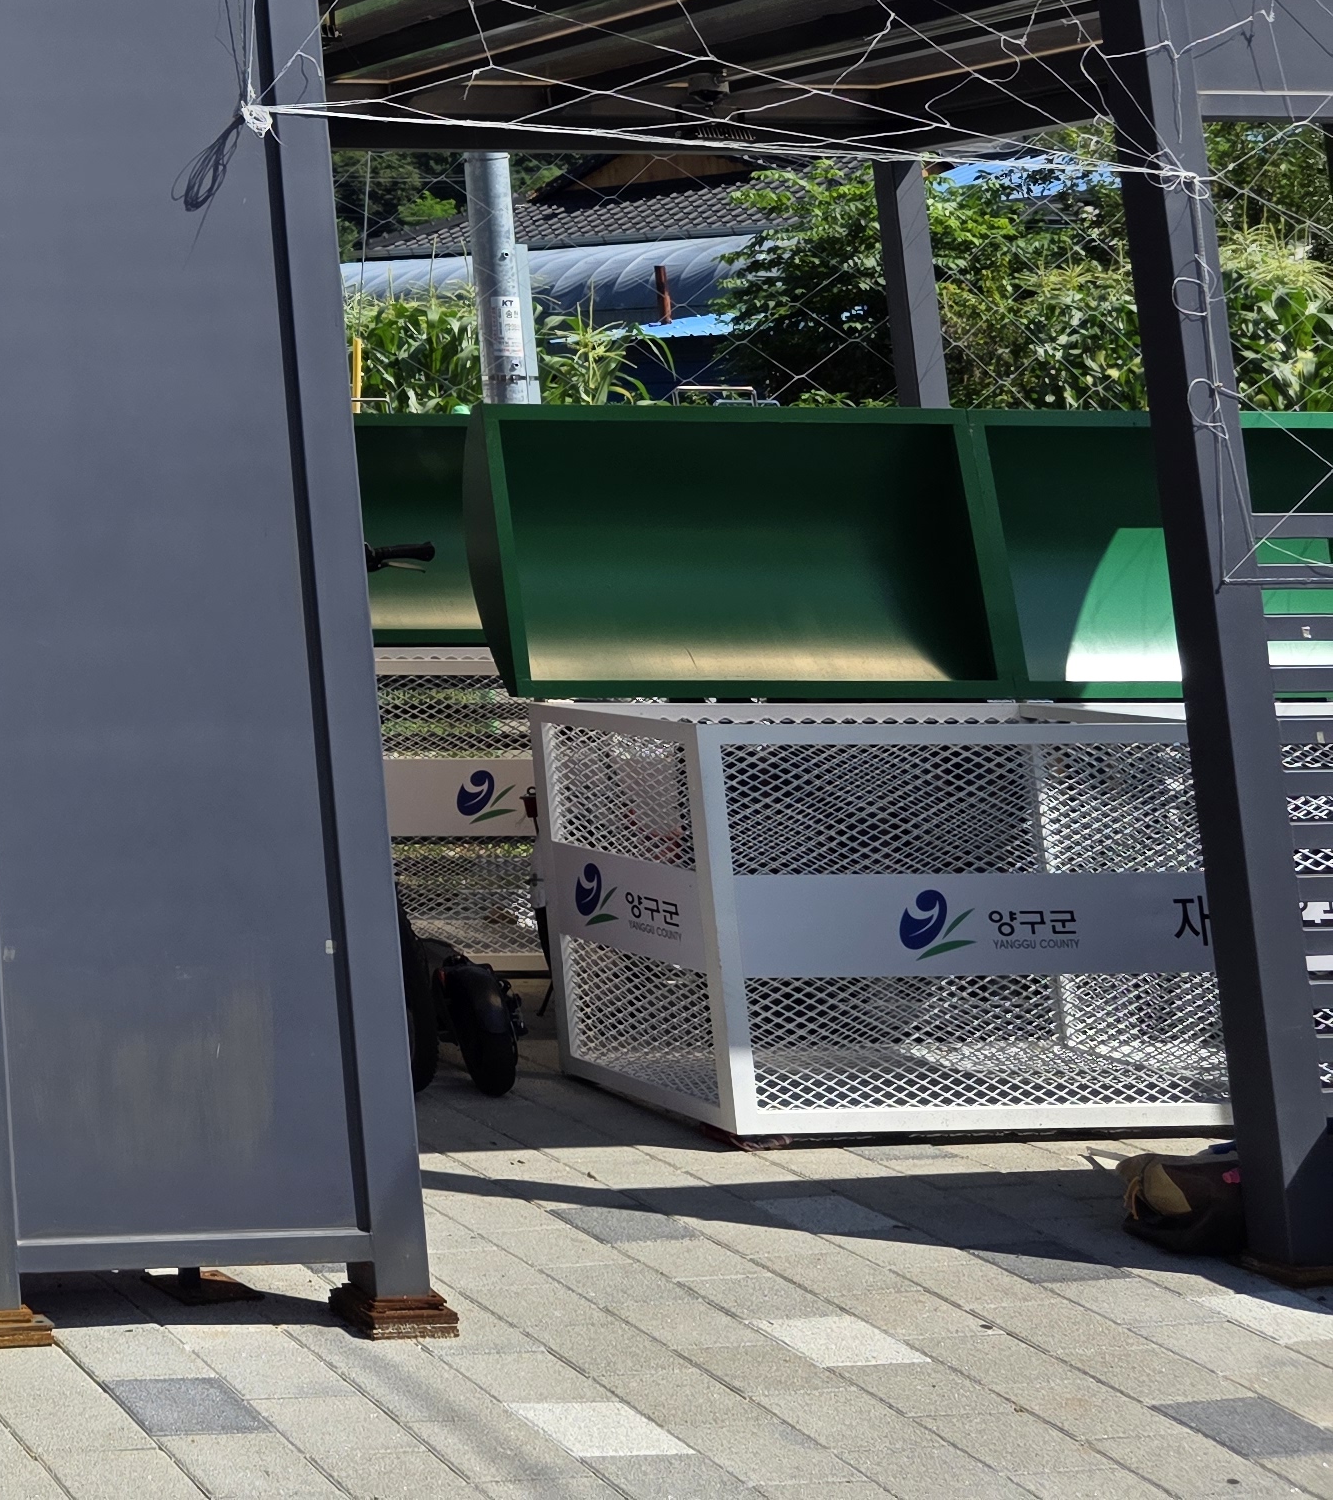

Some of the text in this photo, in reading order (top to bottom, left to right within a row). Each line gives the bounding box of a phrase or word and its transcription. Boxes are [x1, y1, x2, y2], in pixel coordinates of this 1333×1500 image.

[625, 892, 680, 927] 양구군
[629, 920, 682, 942] YANGGU COUNTY
[988, 910, 1077, 937] 양구군
[993, 938, 1080, 950] YANGGU COUNTY
